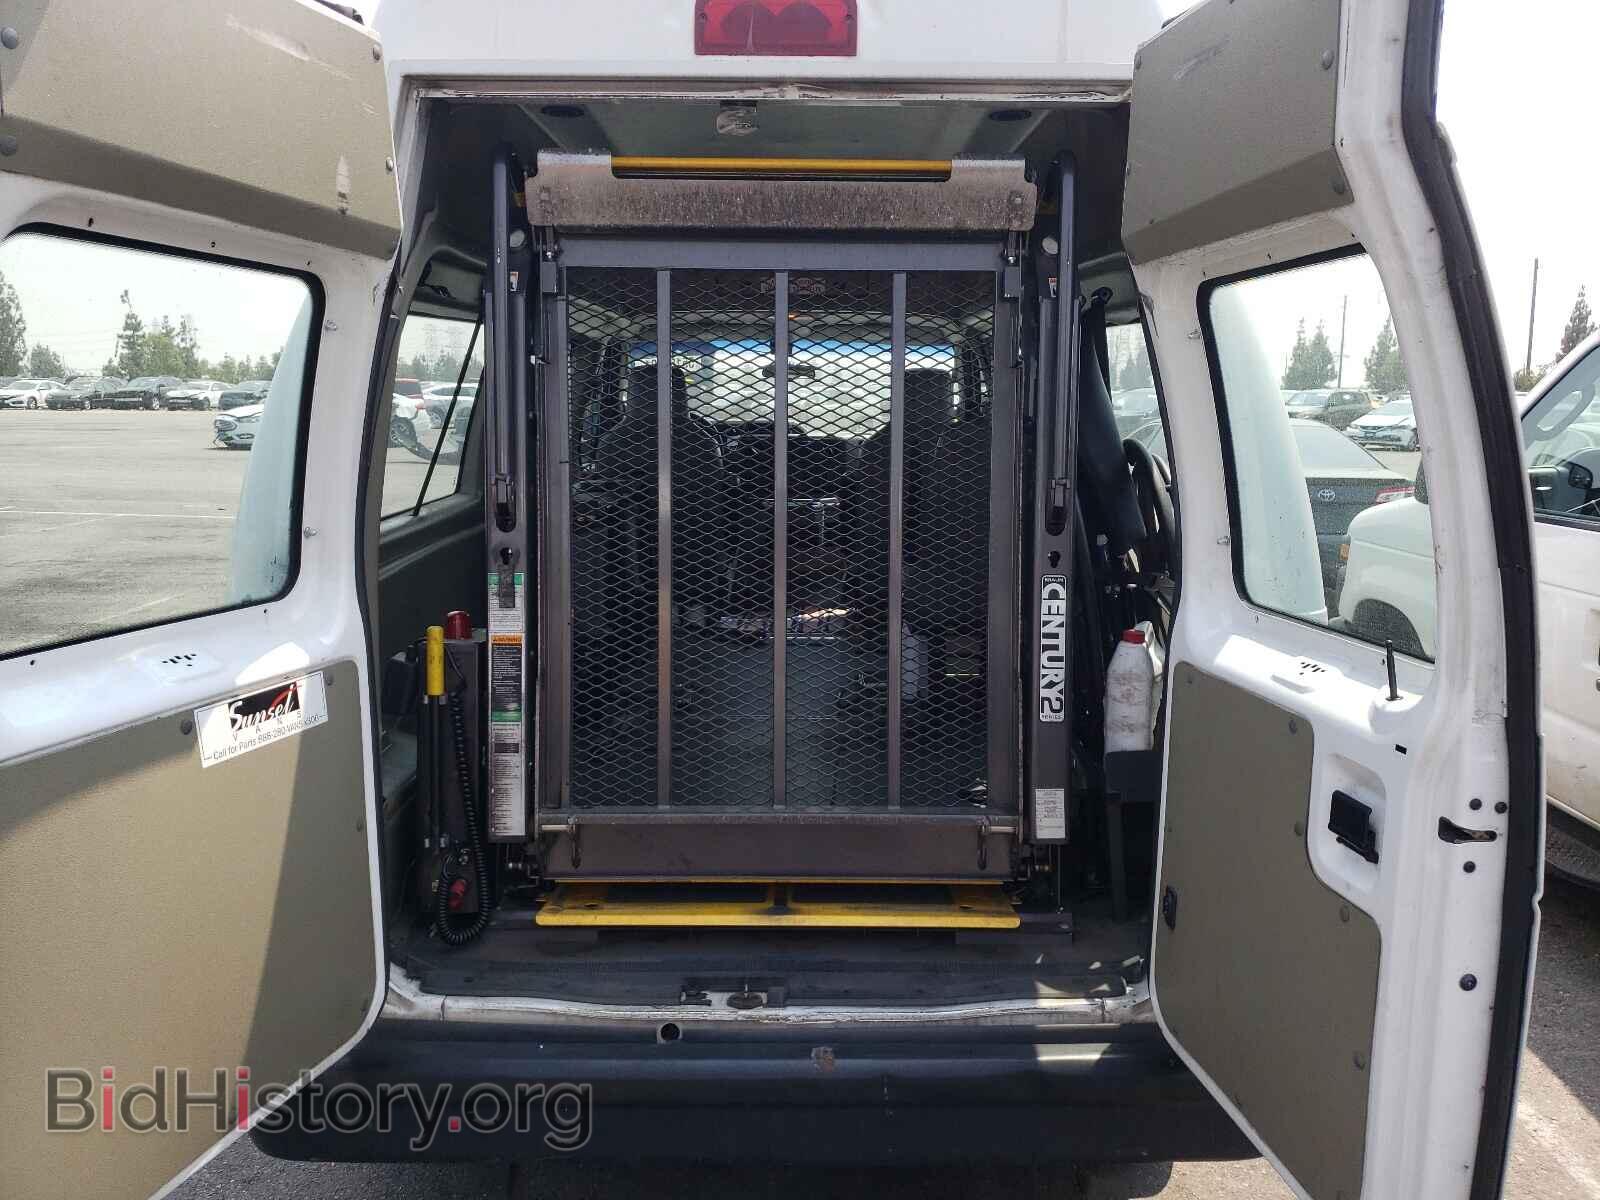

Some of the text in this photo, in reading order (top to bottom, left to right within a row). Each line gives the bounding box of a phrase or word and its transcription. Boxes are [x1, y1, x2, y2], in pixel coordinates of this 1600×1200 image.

[229, 682, 302, 731] Sunset
[213, 746, 227, 761] Call
[227, 744, 238, 756] for
[238, 738, 257, 753] Parts
